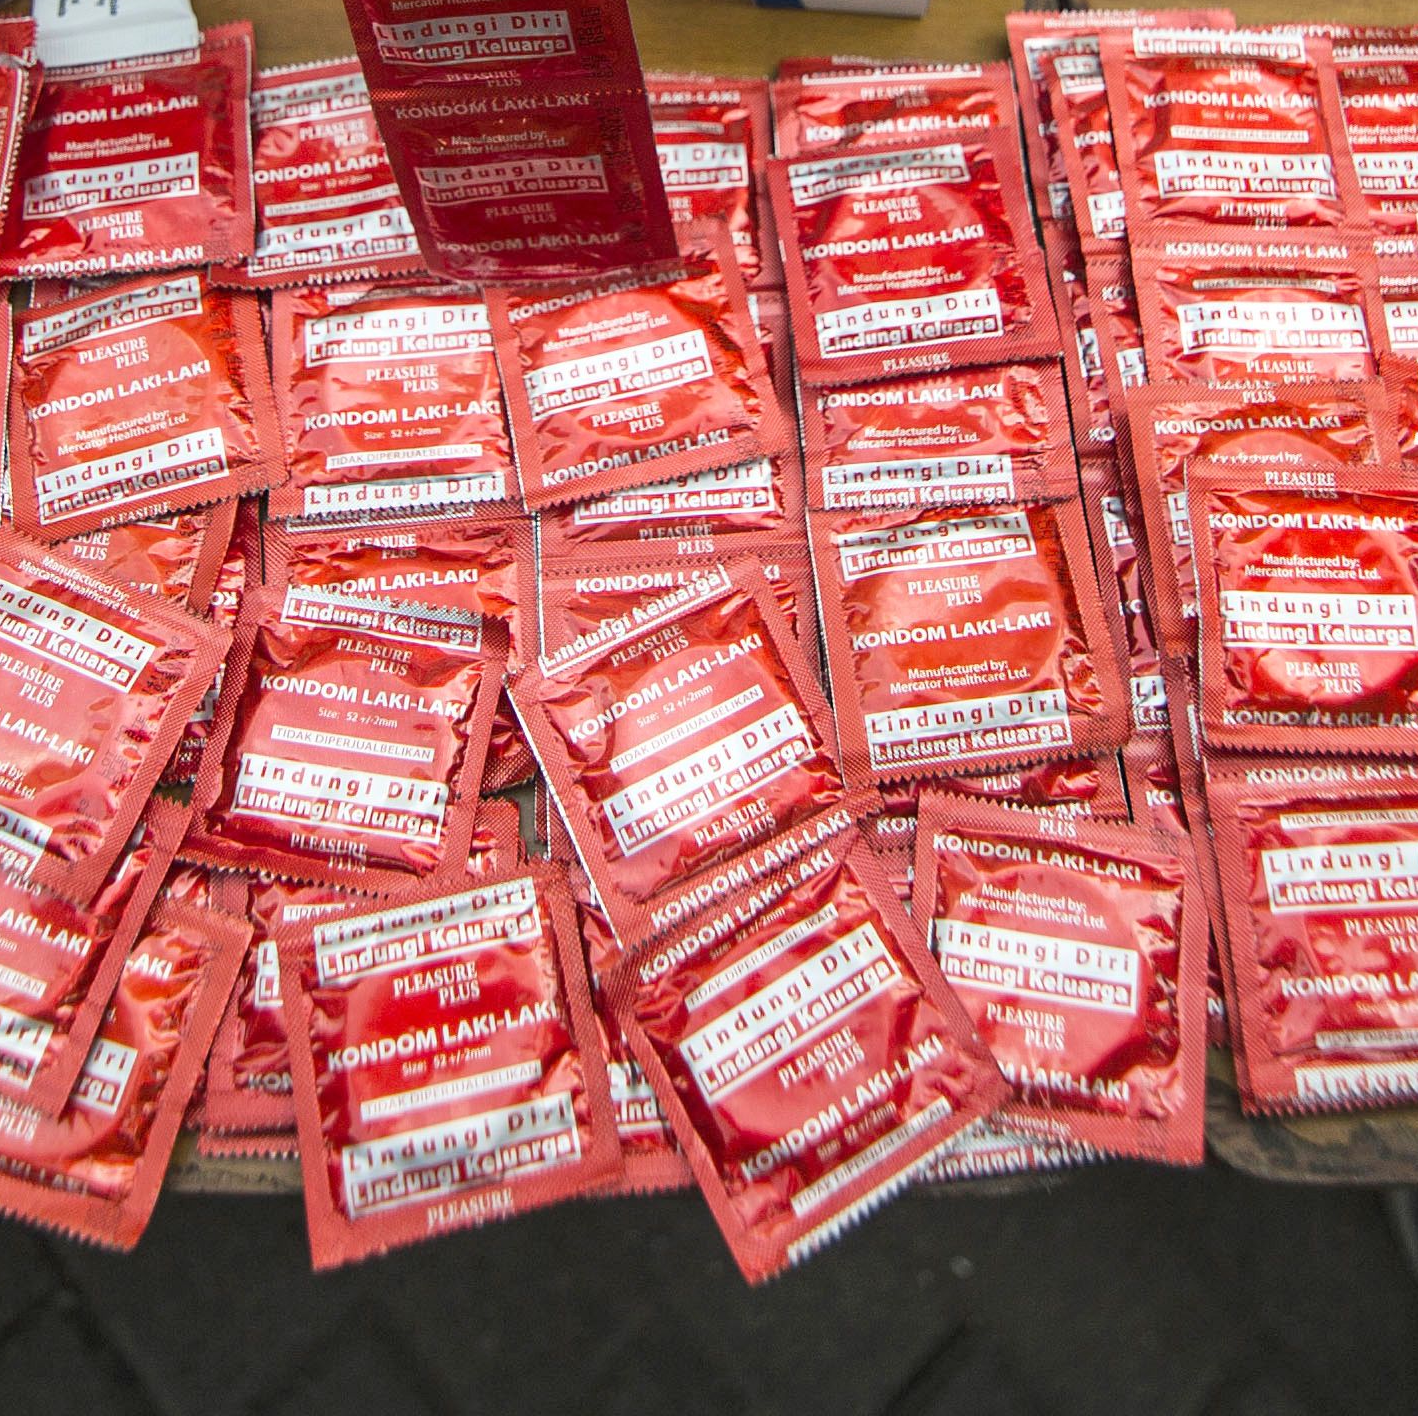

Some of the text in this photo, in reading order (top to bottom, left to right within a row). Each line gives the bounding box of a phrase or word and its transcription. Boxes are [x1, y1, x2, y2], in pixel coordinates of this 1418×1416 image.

[377, 13, 563, 43] Lindungi Diri
[384, 36, 567, 61] Lindungi Keluarga
[852, 195, 919, 214] PLEASURE
[888, 208, 921, 222] PLUS
[803, 224, 984, 259] KONDOM LAKI-LAKI
[821, 294, 992, 330] Lindungi Diri
[1209, 513, 1405, 532] KONDOM LAKI-LAKI
[846, 534, 1029, 576] Lindungi Keluarga
[1263, 553, 1361, 569] Manufactured by:
[1244, 566, 1380, 580] Mercator Healthcare Ltd.
[1224, 597, 1408, 617] Lindungi Diri
[852, 612, 1051, 651] KONDOM LAKI-LAKI
[1224, 621, 1413, 646] Lindungi Keluarga
[20, 679, 57, 708] PLUS
[261, 675, 467, 719] KONDOM LAKI-LAKI
[276, 727, 432, 760] TIDAK DIPERJUALBELIKAN
[243, 762, 441, 807] Lindungi Diri
[237, 787, 433, 834] Lindungi Keluarga
[933, 834, 1141, 882] KONDOM LAKI-LAKI
[393, 962, 477, 997] PLEASURE
[439, 981, 479, 1006] PLUS
[329, 1004, 558, 1071] KONDOM LAKI-LAKI
